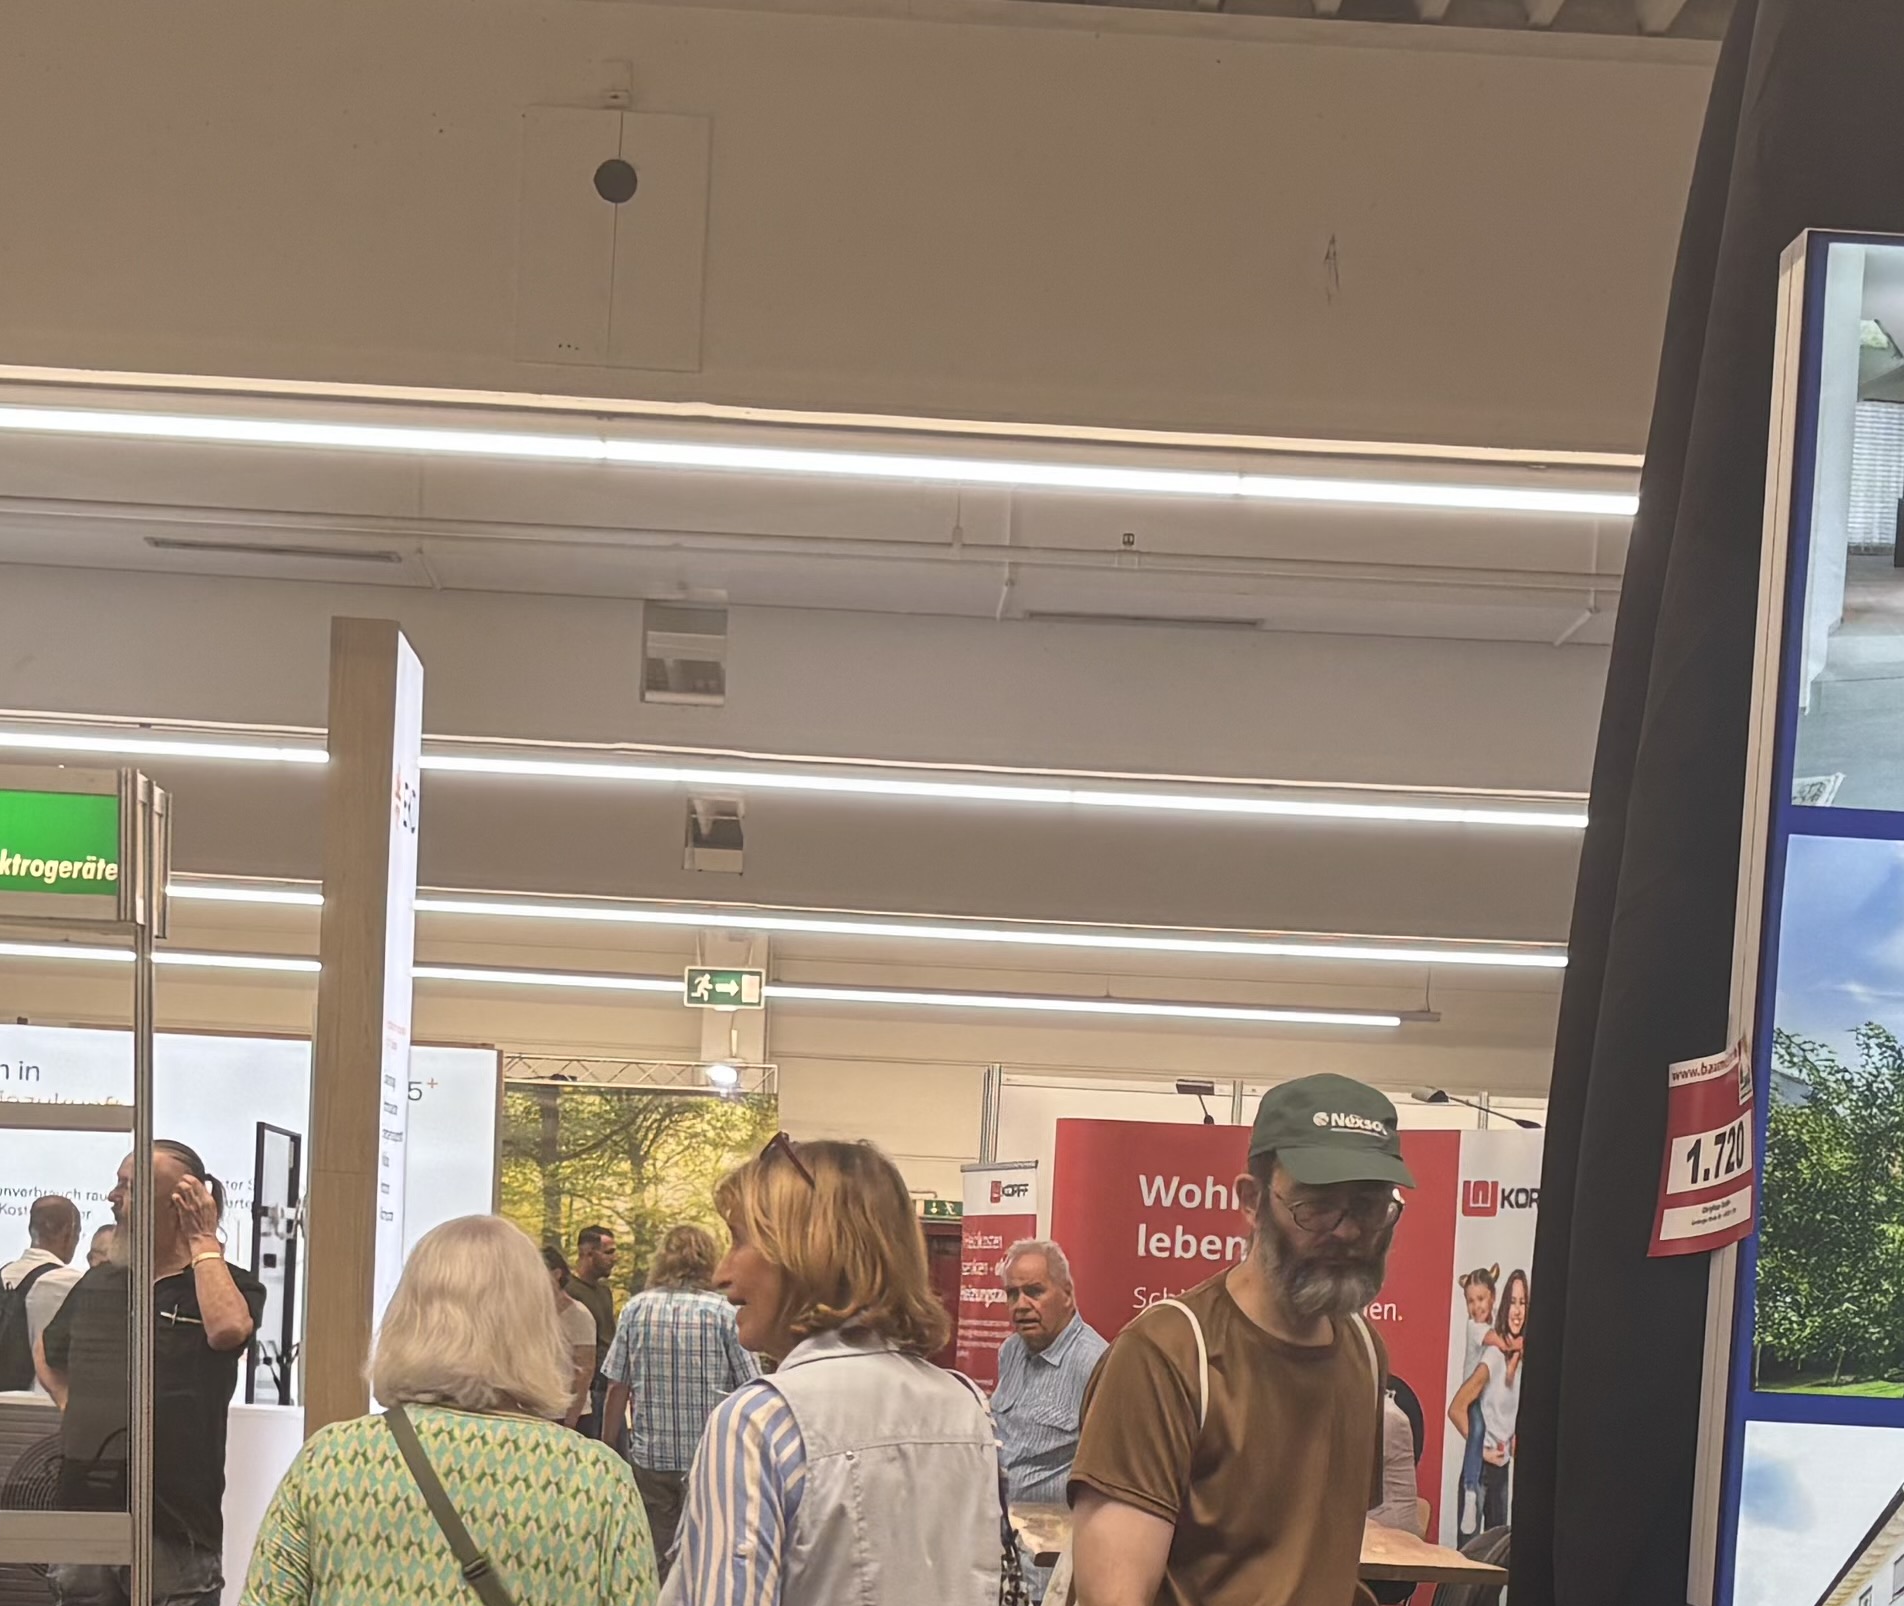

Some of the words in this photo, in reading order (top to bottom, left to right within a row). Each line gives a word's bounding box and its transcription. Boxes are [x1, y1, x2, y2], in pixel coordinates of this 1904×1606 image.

[18, 1061, 40, 1081] in
[1687, 1120, 1745, 1185] 1.720
[1137, 1223, 1249, 1262] leben
